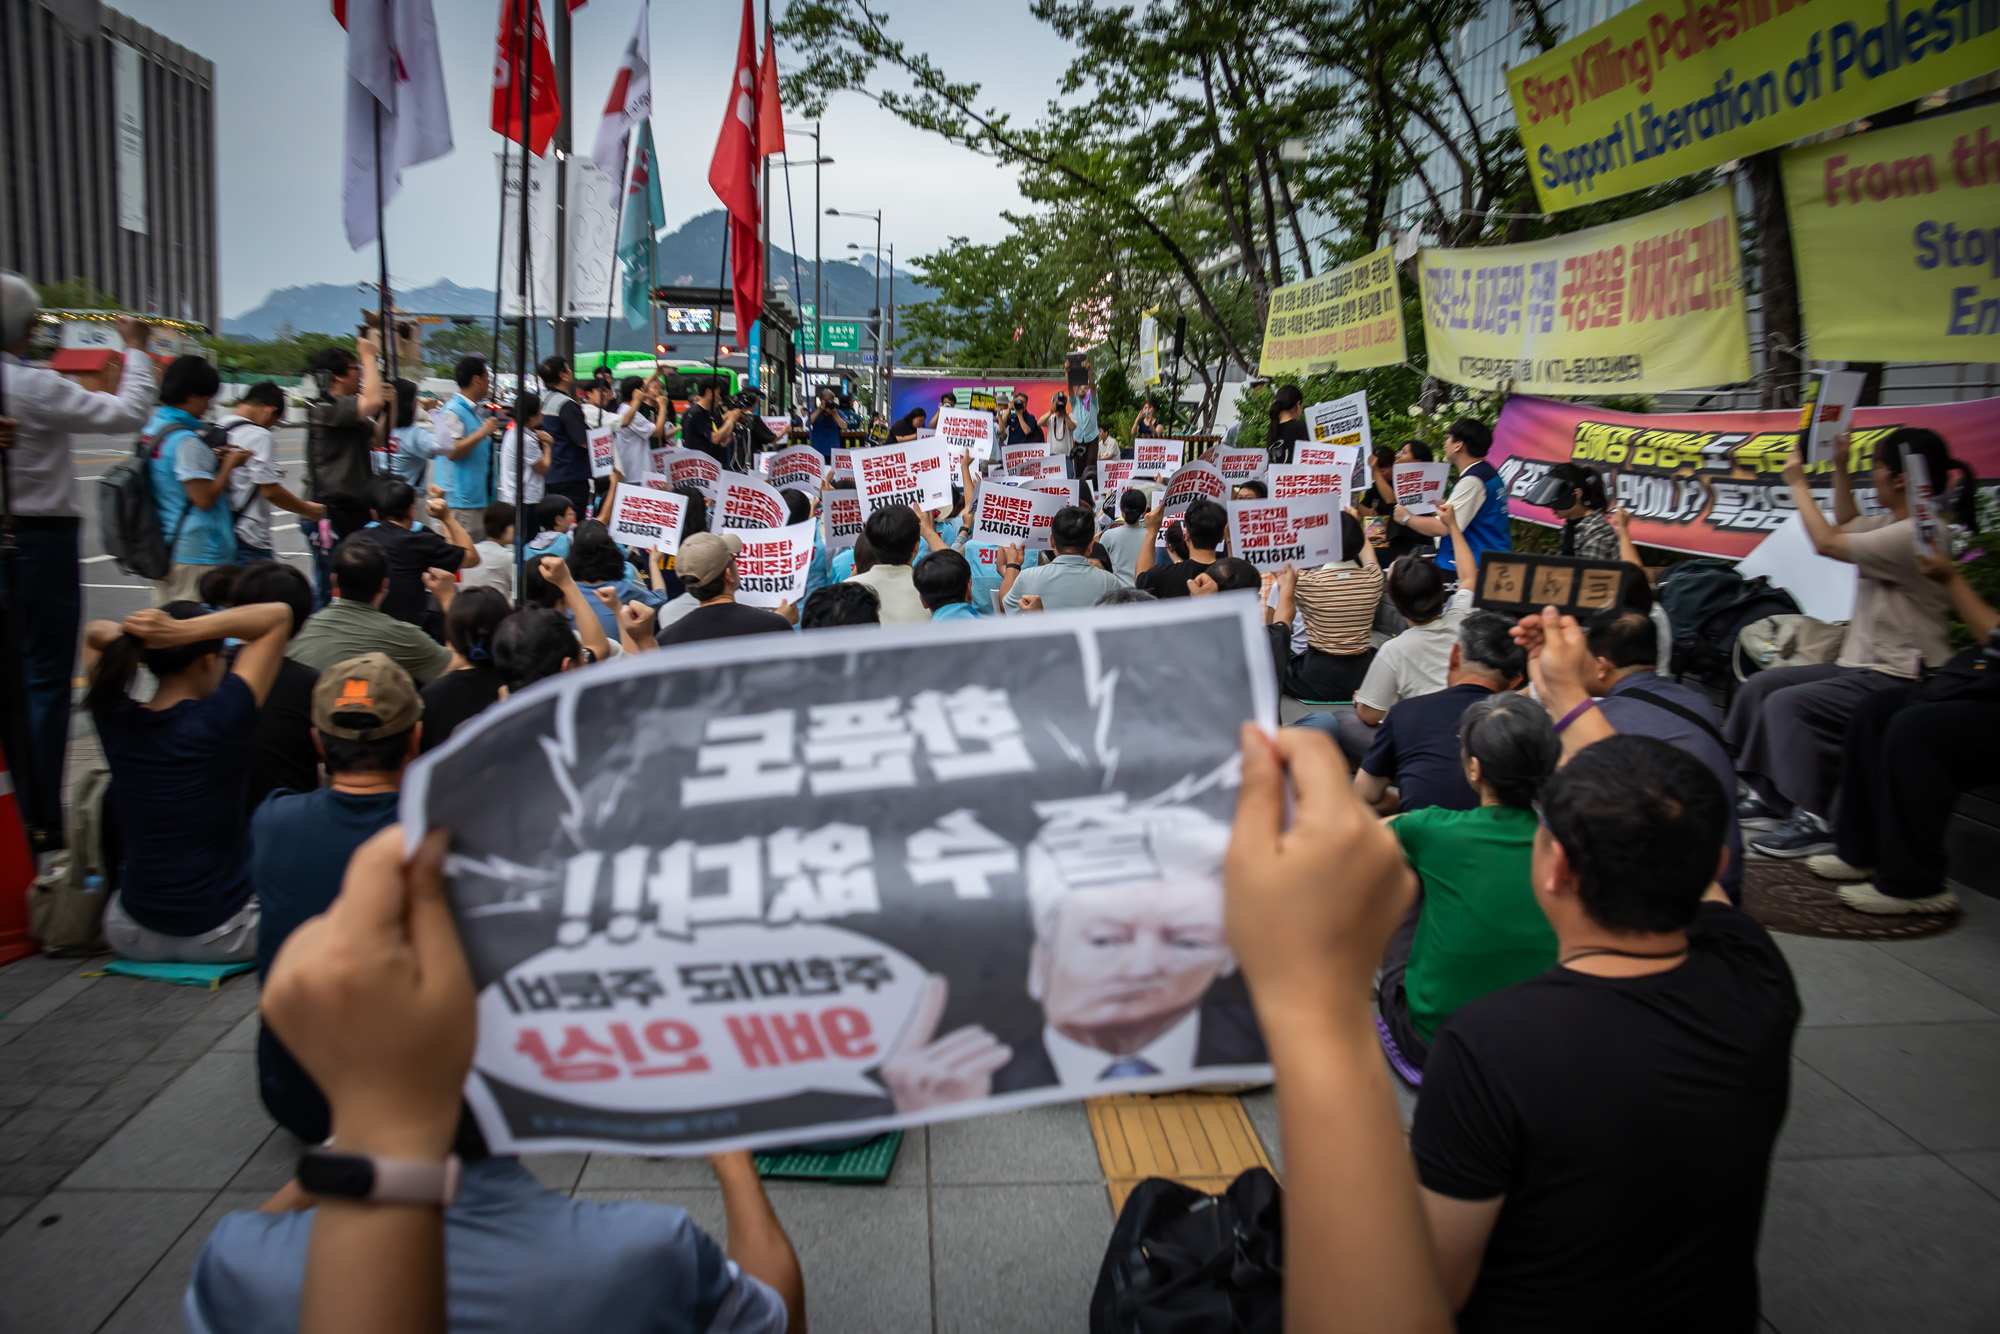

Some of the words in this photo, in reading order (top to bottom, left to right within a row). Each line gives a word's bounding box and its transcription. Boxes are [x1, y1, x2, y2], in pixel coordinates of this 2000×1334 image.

[1522, 72, 1577, 128] Stop
[1570, 35, 1655, 106] Killing
[1537, 118, 1627, 196] Support
[1624, 67, 1779, 165] Liberation
[1784, 30, 1825, 108] of
[1824, 153, 1939, 208] From
[1560, 242, 1627, 332] 국정원을
[861, 452, 907, 471] 중국견제
[863, 465, 908, 483] 주한미군
[909, 456, 941, 475] 주둔비
[865, 481, 893, 496] 10배
[895, 475, 918, 491] 인상
[1275, 473, 1342, 487] 식량주권훼손
[621, 495, 680, 516] 식량주권훼손
[984, 493, 1032, 513] 관세폭탄
[620, 508, 678, 529] 위생검역훼손
[982, 507, 1030, 526] 경제주권
[1238, 506, 1288, 523] 중국견제
[1239, 519, 1289, 536] 주한미군
[1291, 512, 1329, 530] 주둔비
[617, 520, 663, 539] 저지하자!
[979, 519, 1031, 539] 저지하자!
[1241, 534, 1270, 549] 10배
[1273, 531, 1298, 546] 인상
[1241, 544, 1306, 565] 저지하자!
